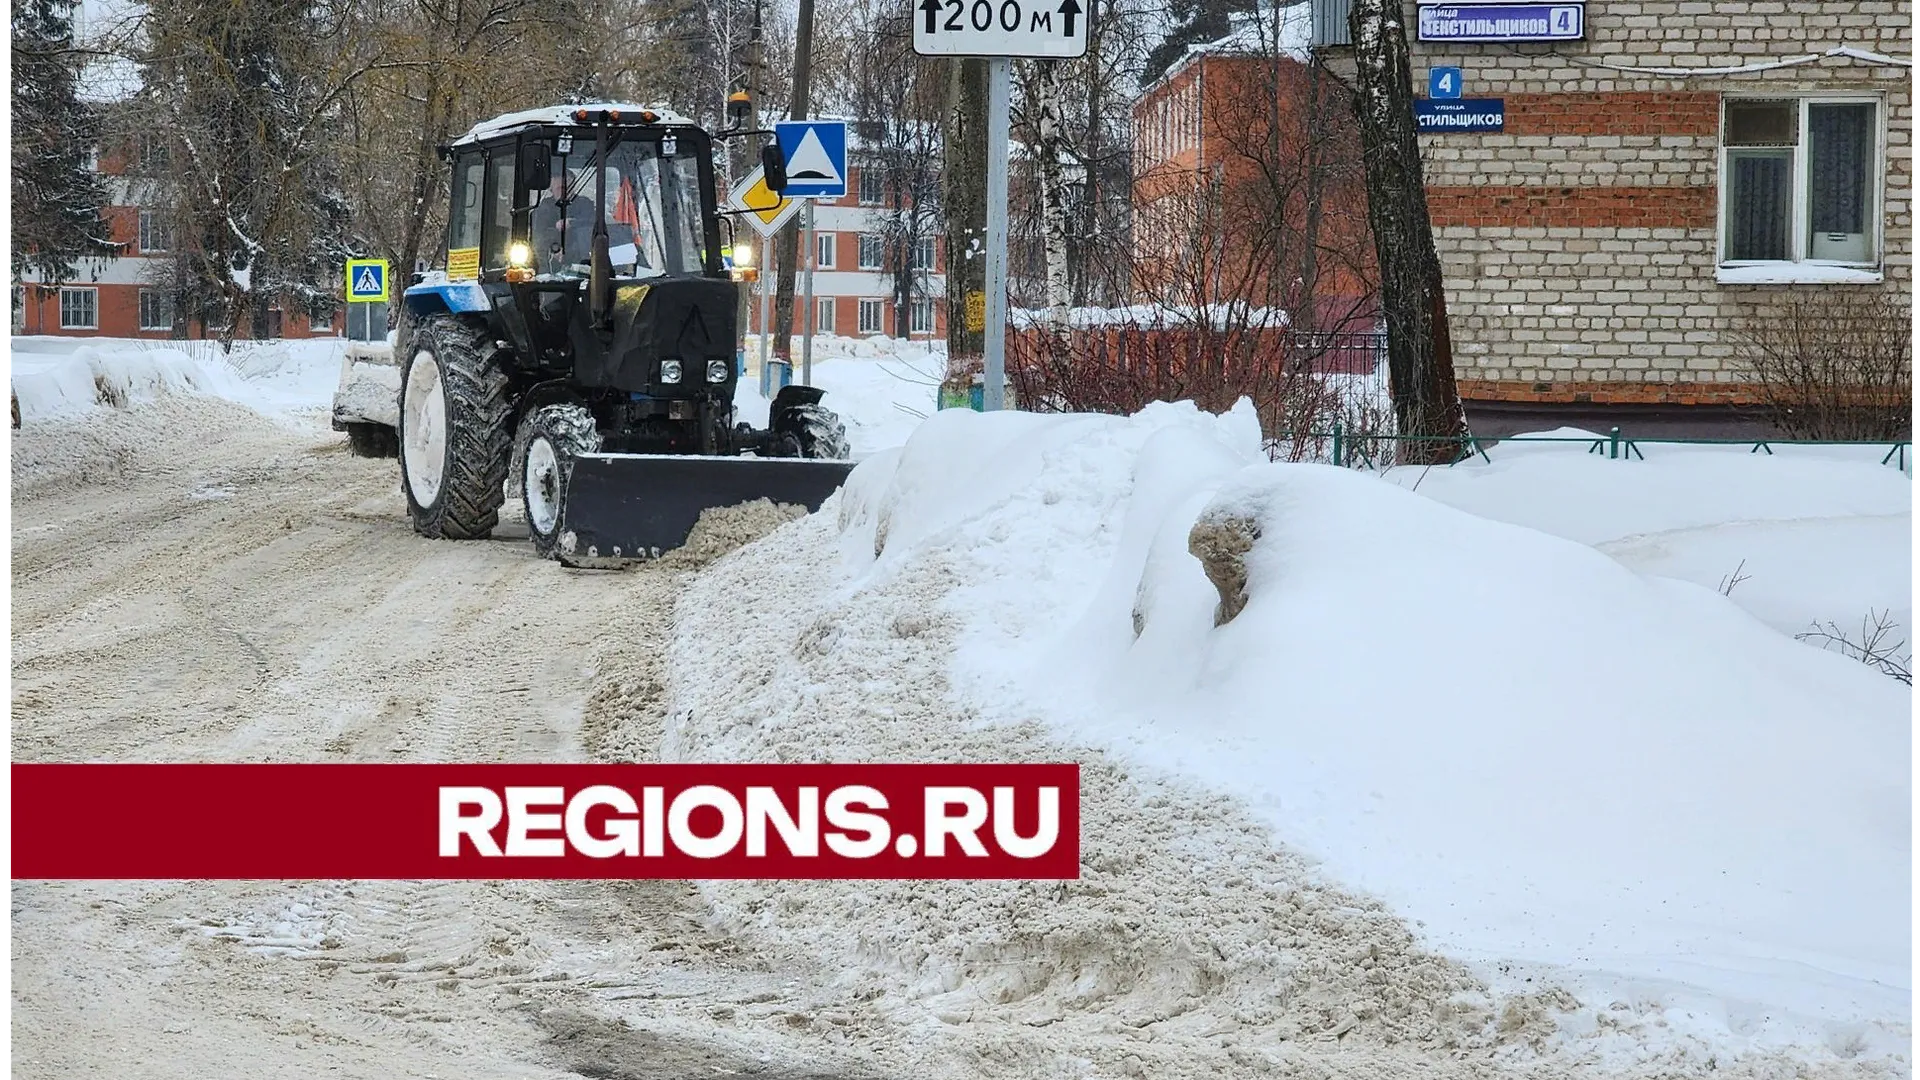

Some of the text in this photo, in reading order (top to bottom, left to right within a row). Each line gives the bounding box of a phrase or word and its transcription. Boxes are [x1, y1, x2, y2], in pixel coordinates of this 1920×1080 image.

[944, 0, 1021, 32] 200
[1557, 11, 1570, 31] 4
[1438, 73, 1451, 93] 4
[1416, 113, 1503, 127] СТИЛЬЩИКОВ
